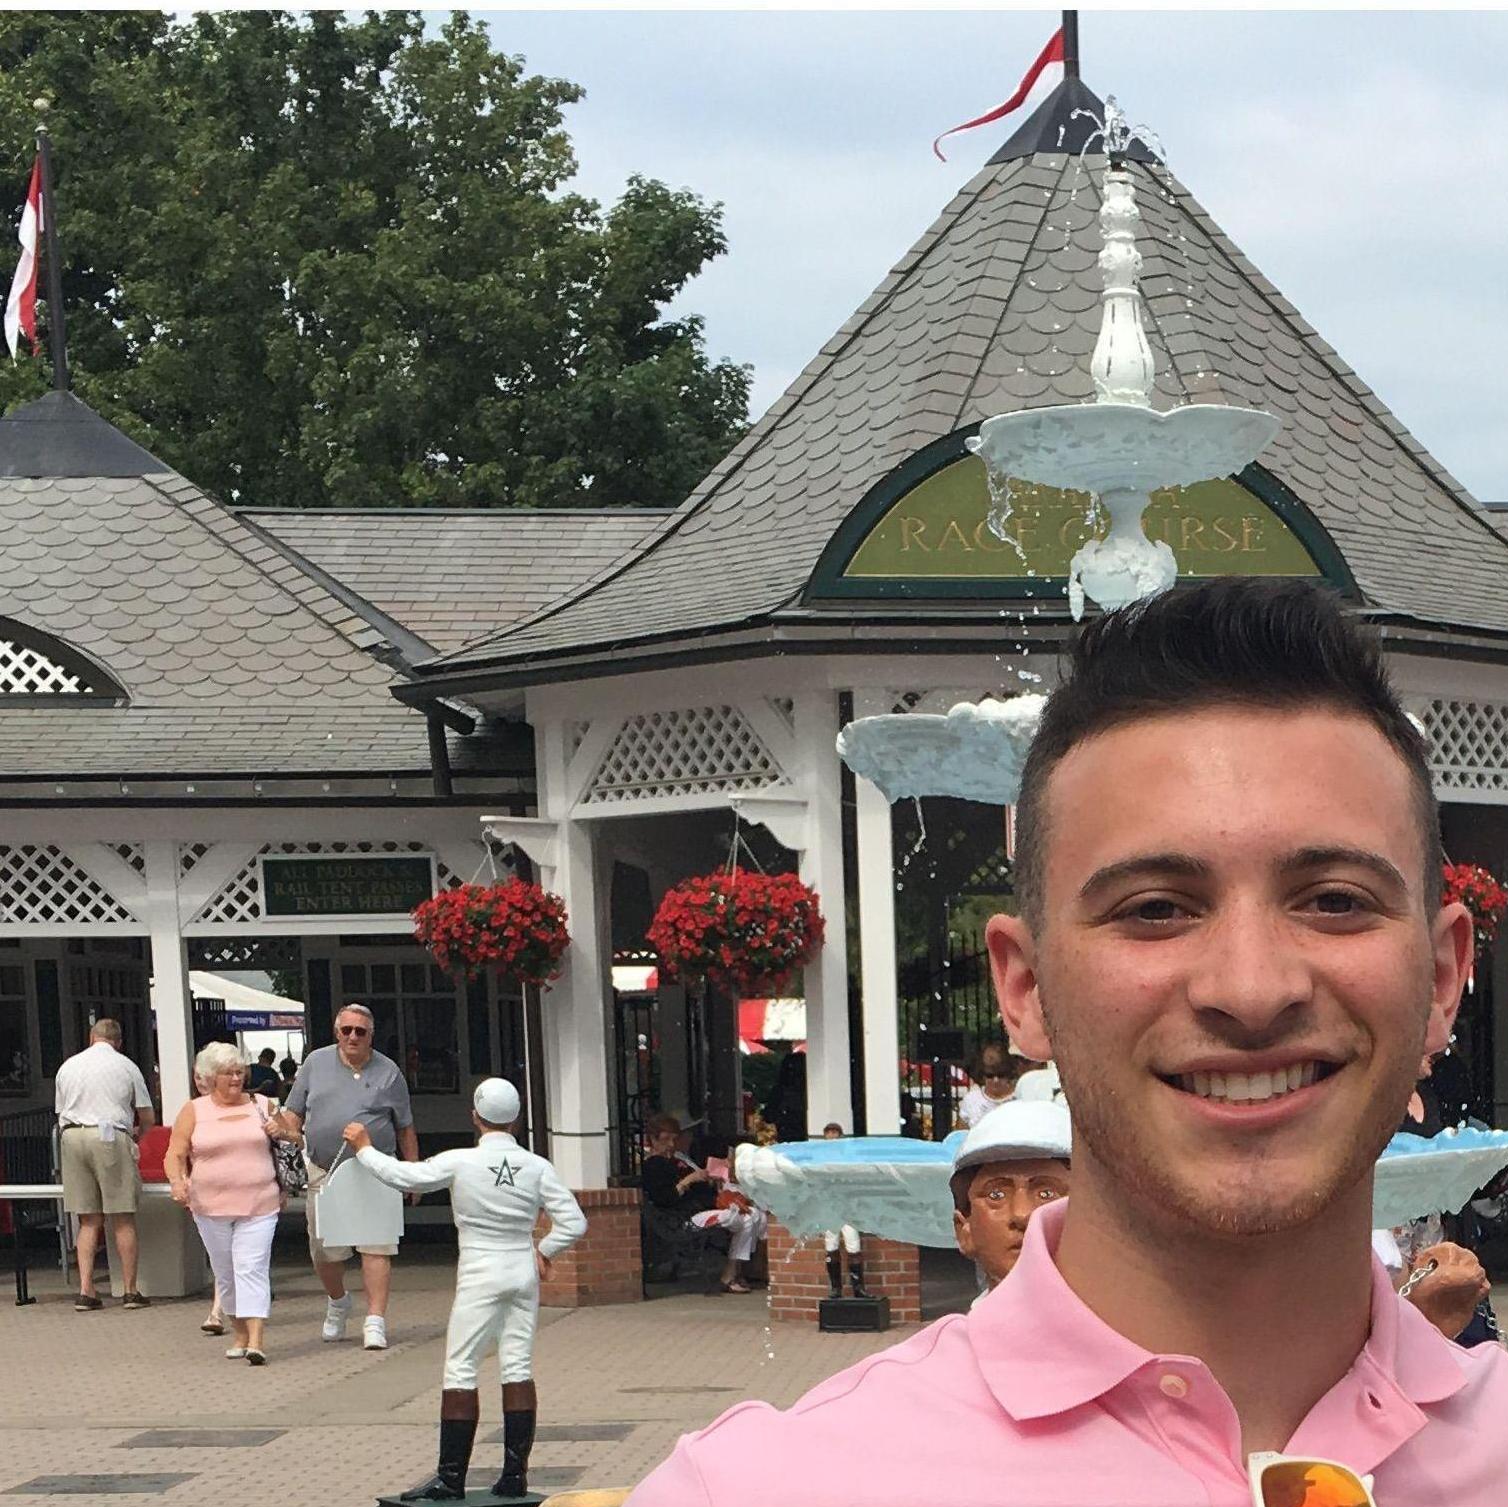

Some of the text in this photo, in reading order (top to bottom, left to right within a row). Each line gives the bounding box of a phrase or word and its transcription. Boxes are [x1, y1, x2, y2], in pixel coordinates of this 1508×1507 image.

[900, 515, 1042, 552] RACE
[295, 896, 403, 911] ENTER HERE
